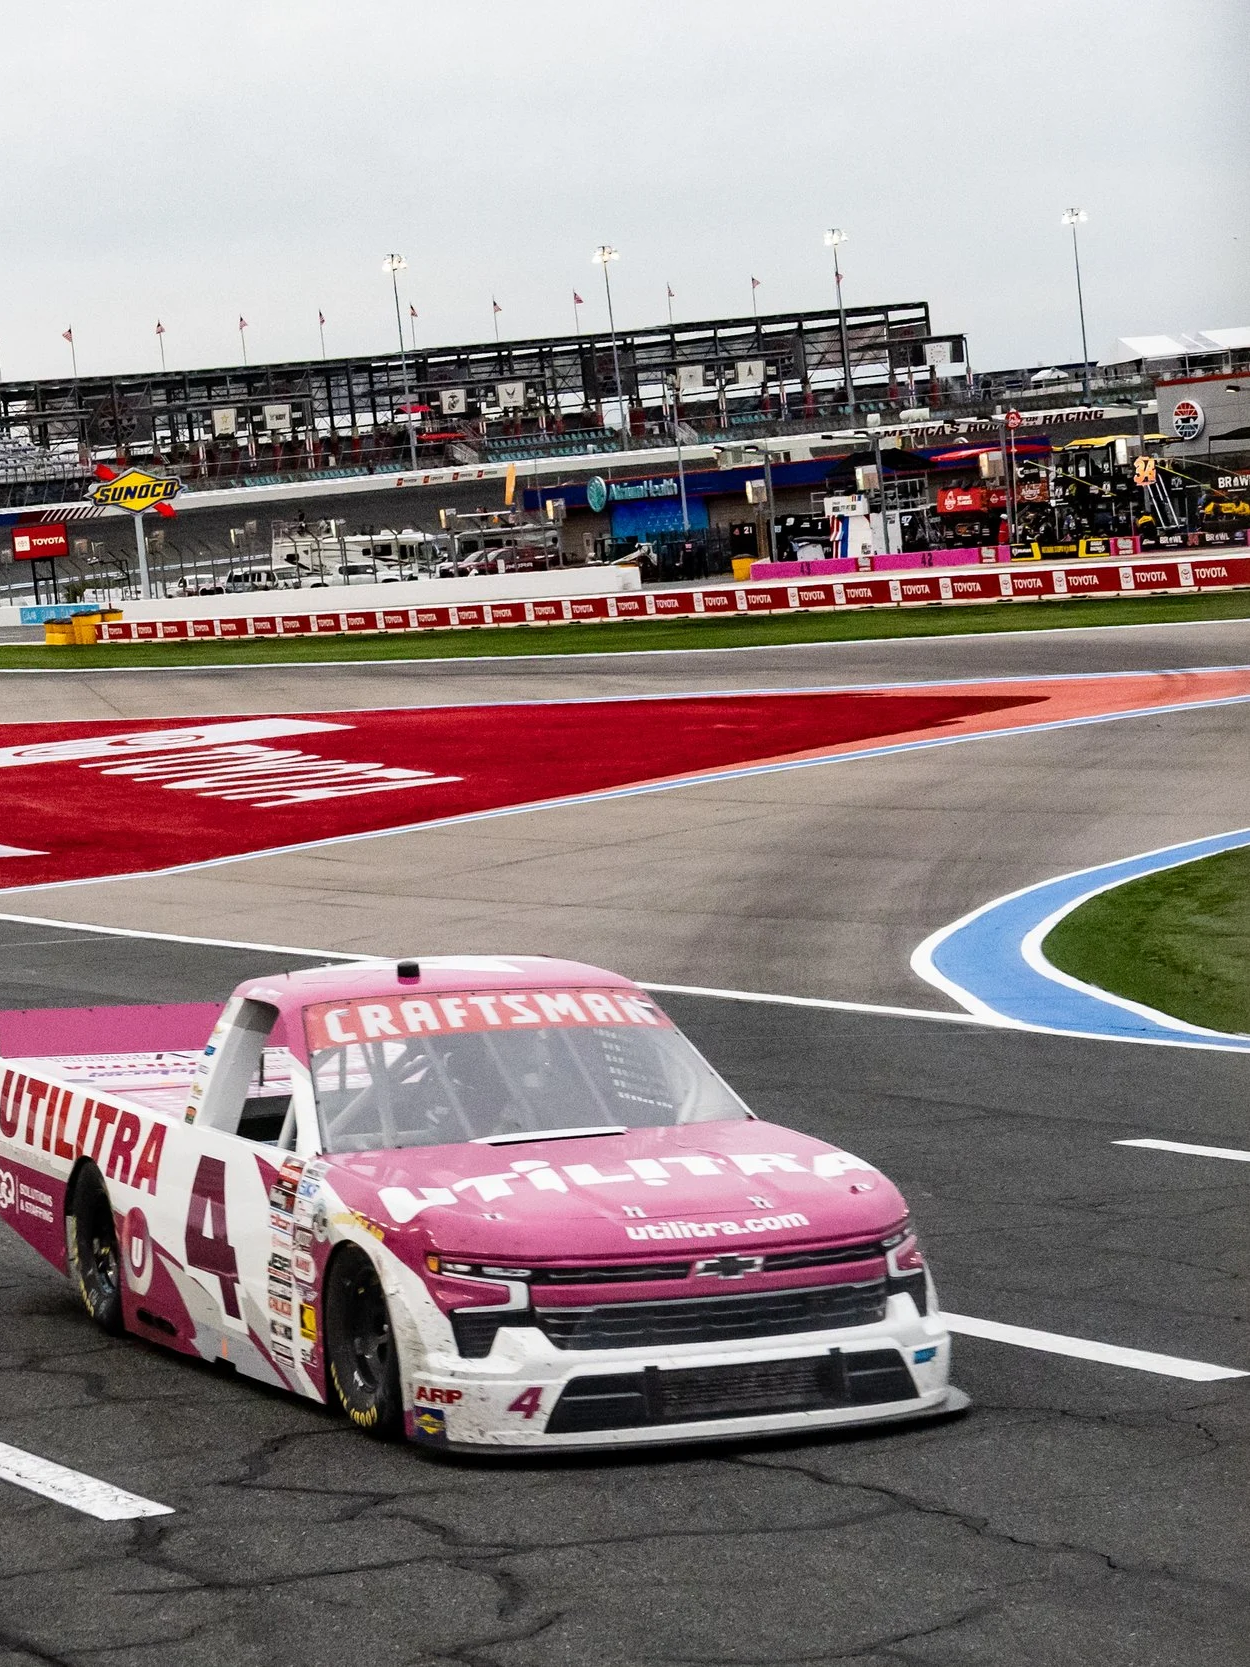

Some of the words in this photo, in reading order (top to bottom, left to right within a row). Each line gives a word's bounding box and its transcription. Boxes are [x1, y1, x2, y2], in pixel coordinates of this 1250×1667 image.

[880, 422, 960, 438] MERICA'S
[1042, 410, 1104, 425] RACING
[96, 480, 178, 505] SUNOCO
[32, 536, 66, 546] TOYOTA
[1135, 572, 1167, 582] TOYOTA
[1194, 567, 1227, 578] TOYOTA
[1013, 578, 1042, 589] TOYOTA
[1068, 575, 1099, 585] TOYOTA
[902, 585, 930, 594] TOYOTA
[953, 583, 981, 592] TOYOTA
[800, 591, 825, 600] TOYOTA
[846, 588, 872, 598] TOYOTA
[656, 599, 678, 608] TOYOTA
[705, 597, 728, 606] TOYOTA
[748, 595, 771, 603] TOYOTA
[572, 605, 593, 613] TOYOTA
[617, 602, 639, 610] TOYOTA
[458, 611, 477, 619] TOYOTA
[493, 609, 511, 617] TOYOTA
[534, 607, 555, 615] TOYOTA
[348, 617, 365, 625] TOYOTA
[418, 614, 437, 622] TOYOTA
[255, 622, 271, 630] TOYOTA
[283, 621, 300, 629] TOYOTA
[318, 619, 334, 628] TOYOTA
[325, 993, 658, 1043] CRAFTSMAN
[378, 1150, 873, 1223] UTILITRA
[624, 1211, 810, 1241] utilitra.com
[185, 1154, 243, 1321] 4
[415, 1386, 463, 1405] ARP
[507, 1386, 544, 1420] 4
